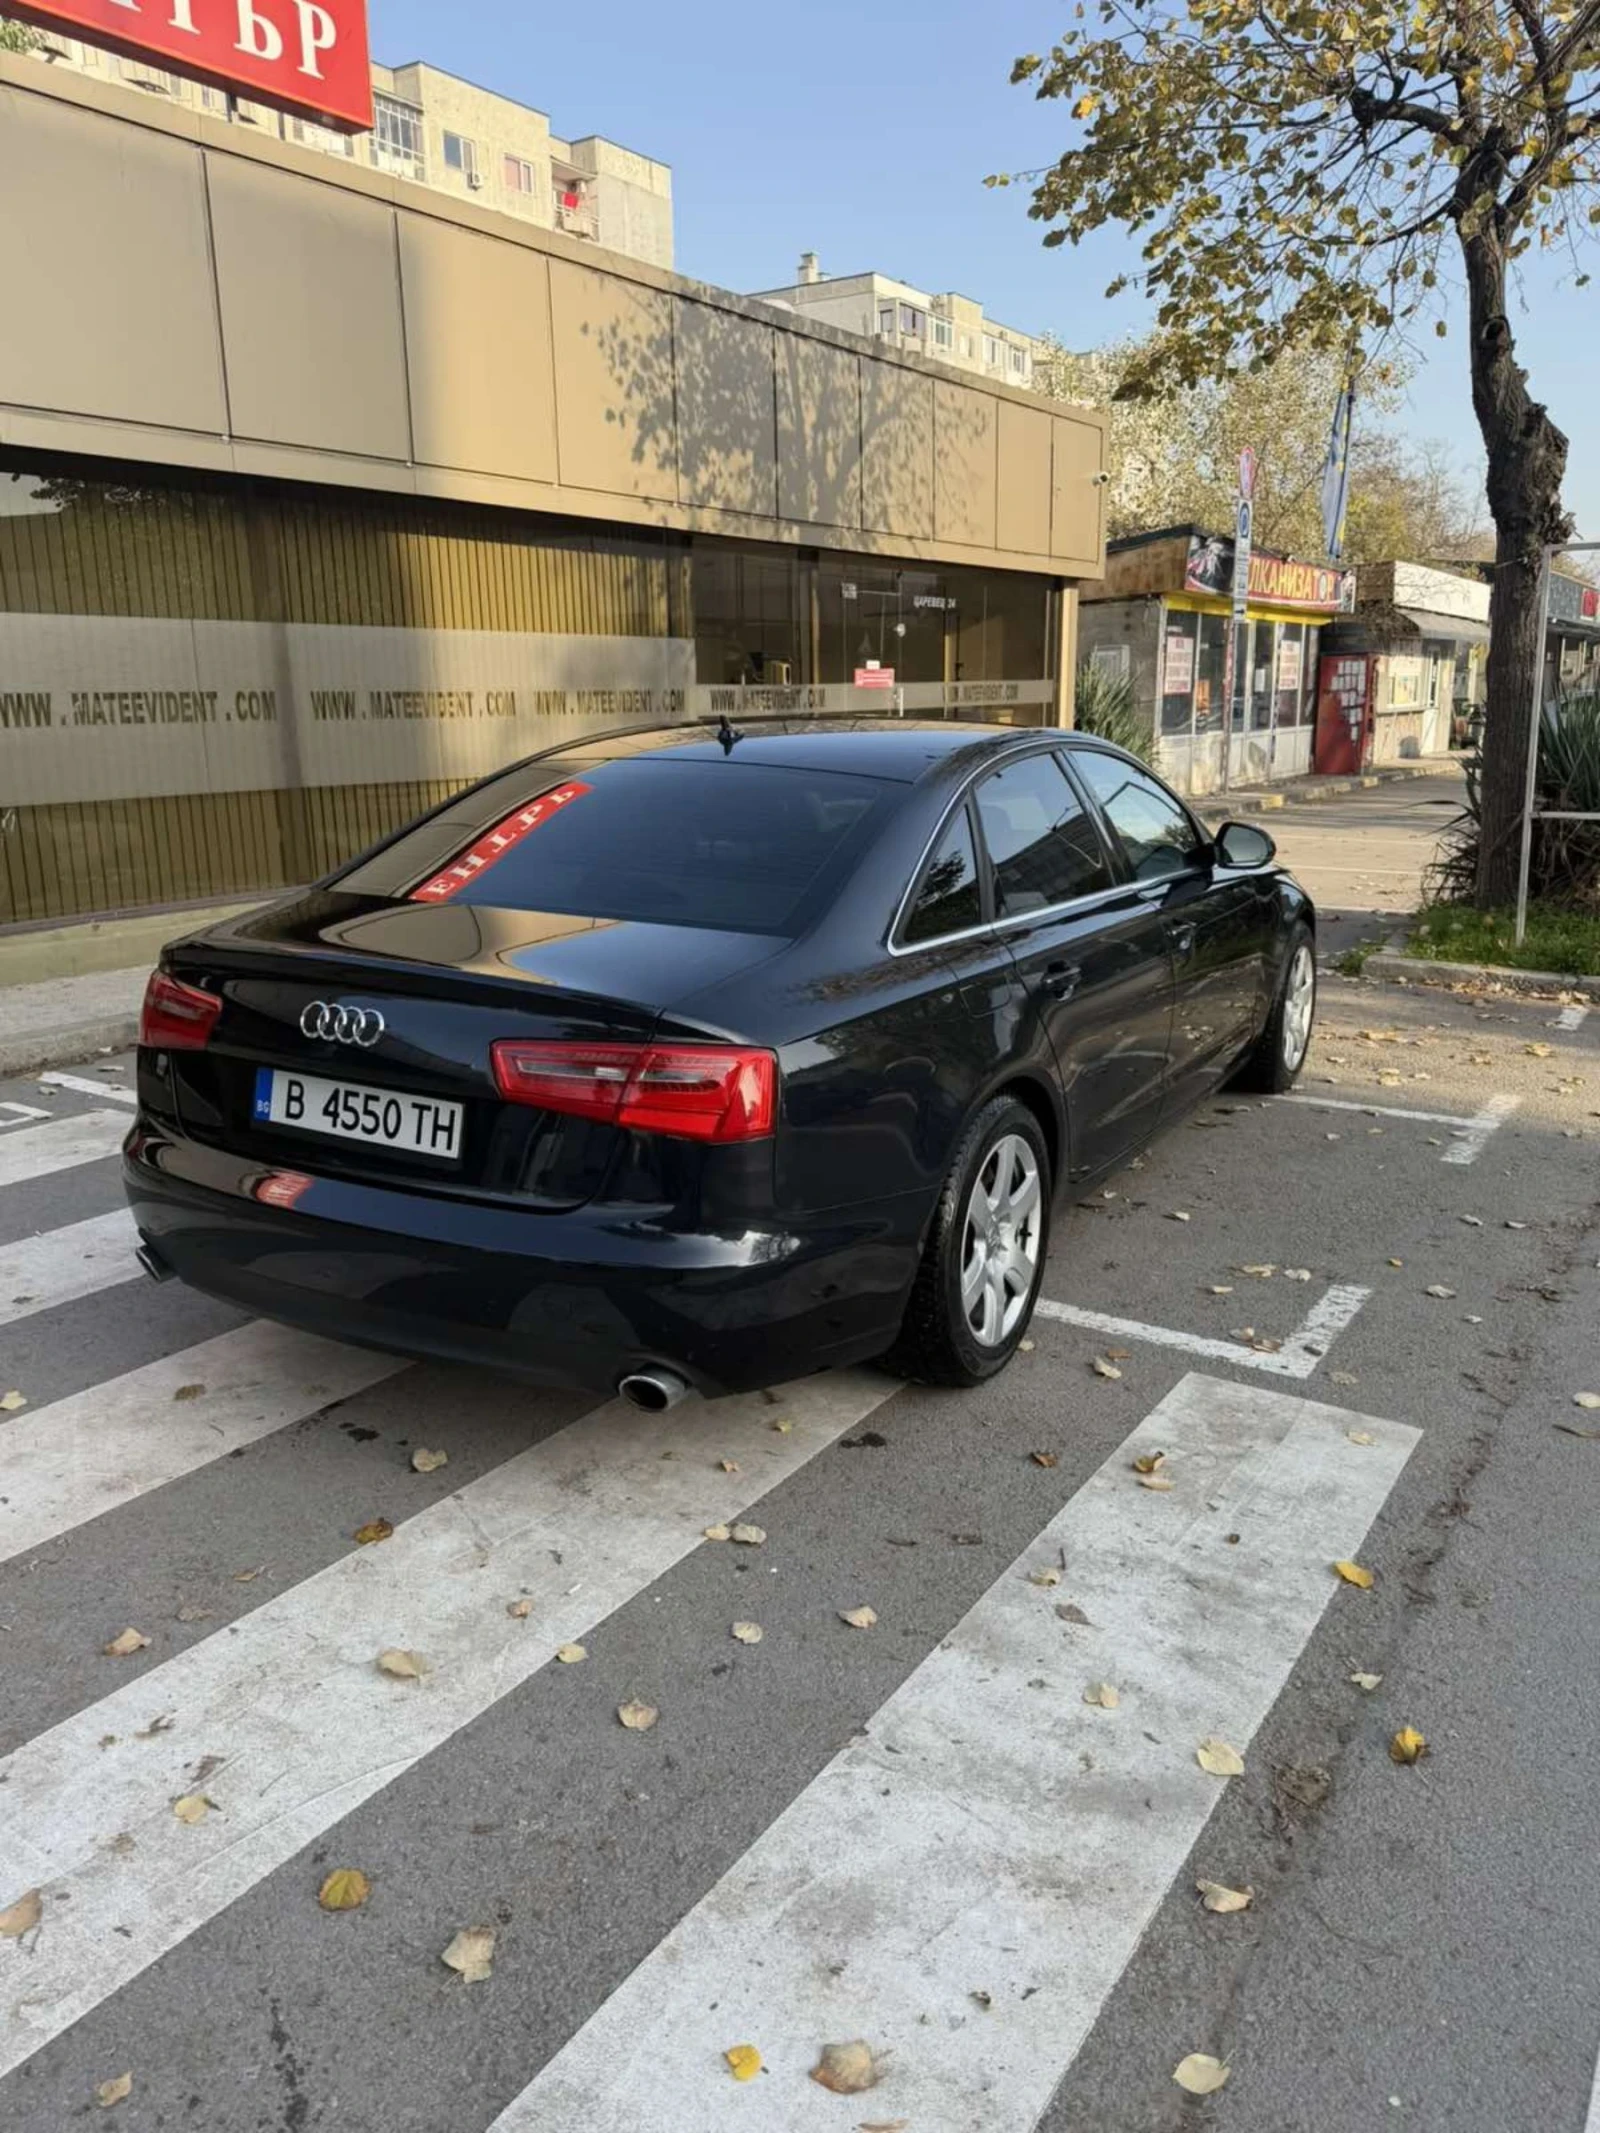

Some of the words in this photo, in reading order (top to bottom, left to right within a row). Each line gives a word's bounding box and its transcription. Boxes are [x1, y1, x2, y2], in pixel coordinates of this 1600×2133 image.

[285, 1079, 305, 1121] B
[322, 1087, 402, 1139] 4550
[411, 1102, 456, 1151] TH
